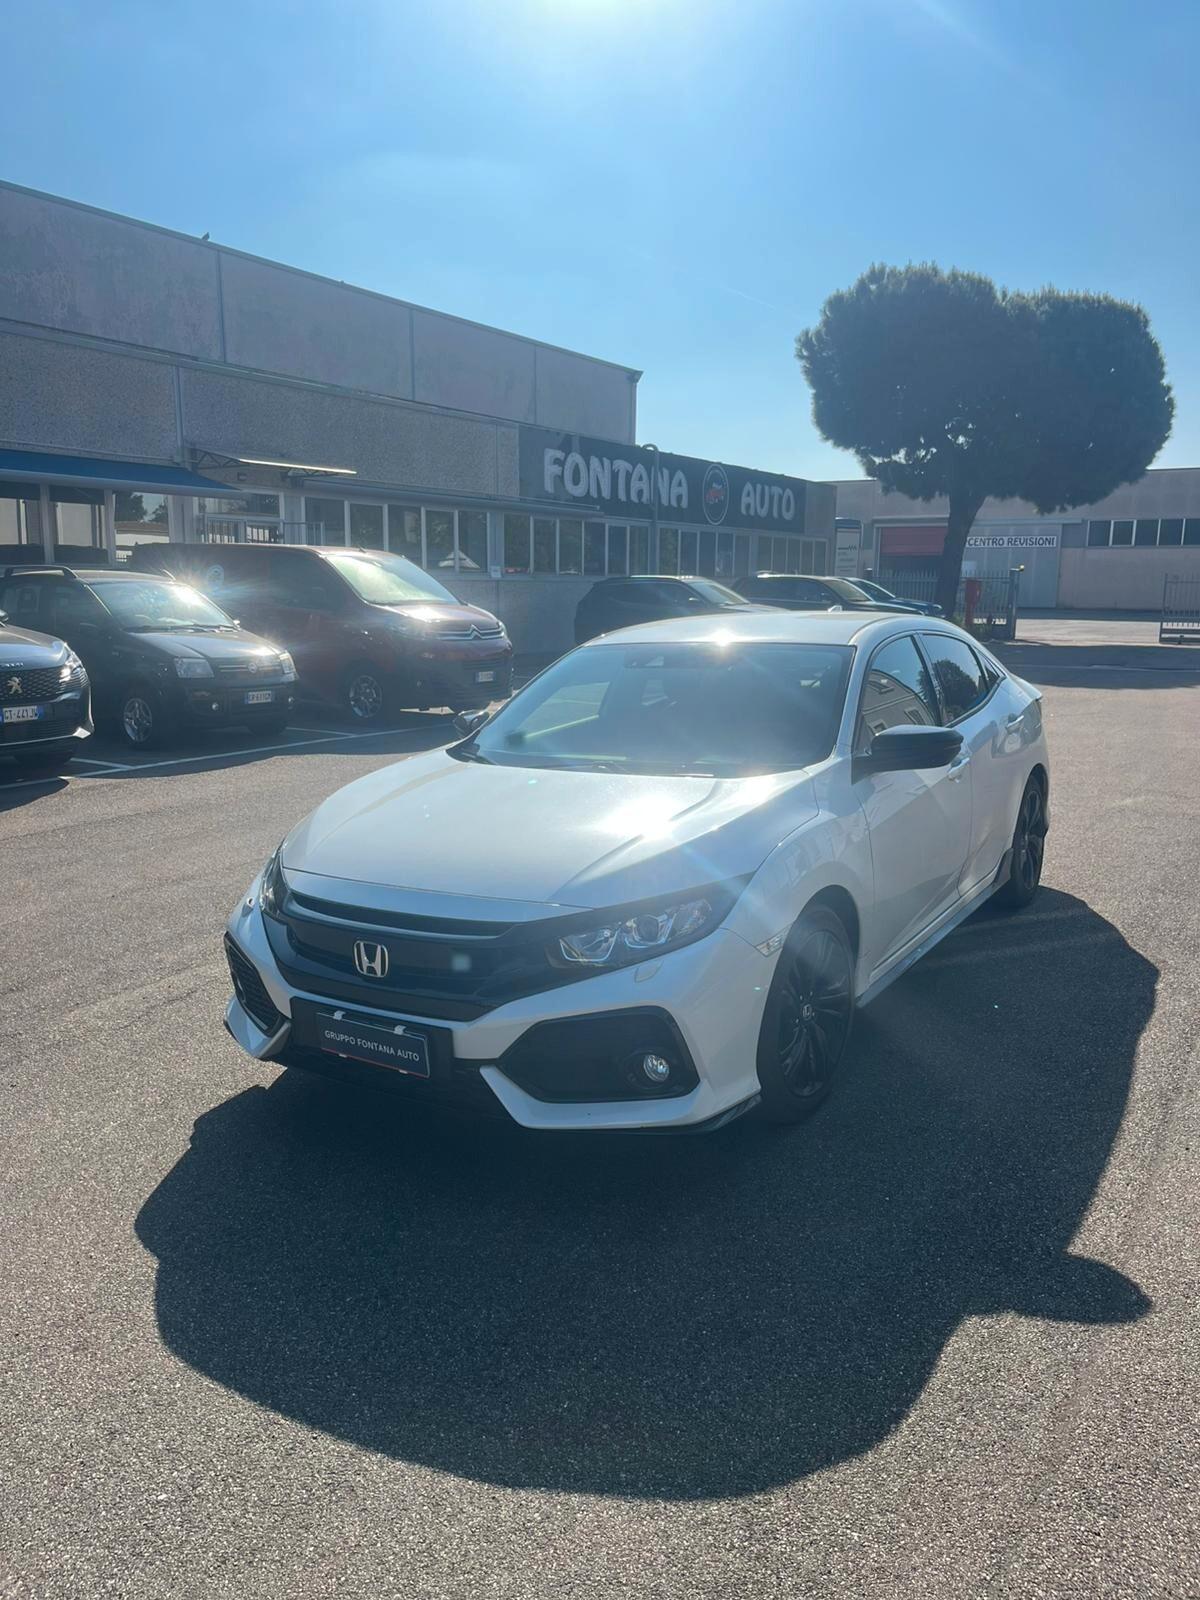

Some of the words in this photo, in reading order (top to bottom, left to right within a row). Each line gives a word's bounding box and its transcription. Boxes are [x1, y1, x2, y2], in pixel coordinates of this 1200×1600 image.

[544, 448, 688, 508] FONTANA
[741, 481, 795, 520] AUTO
[967, 536, 1005, 547] CENTRO
[1007, 536, 1055, 547] REVISIONI
[324, 1030, 356, 1045] GRUPPO
[357, 1039, 395, 1056] FONTANA
[397, 1050, 420, 1061] AUTO
